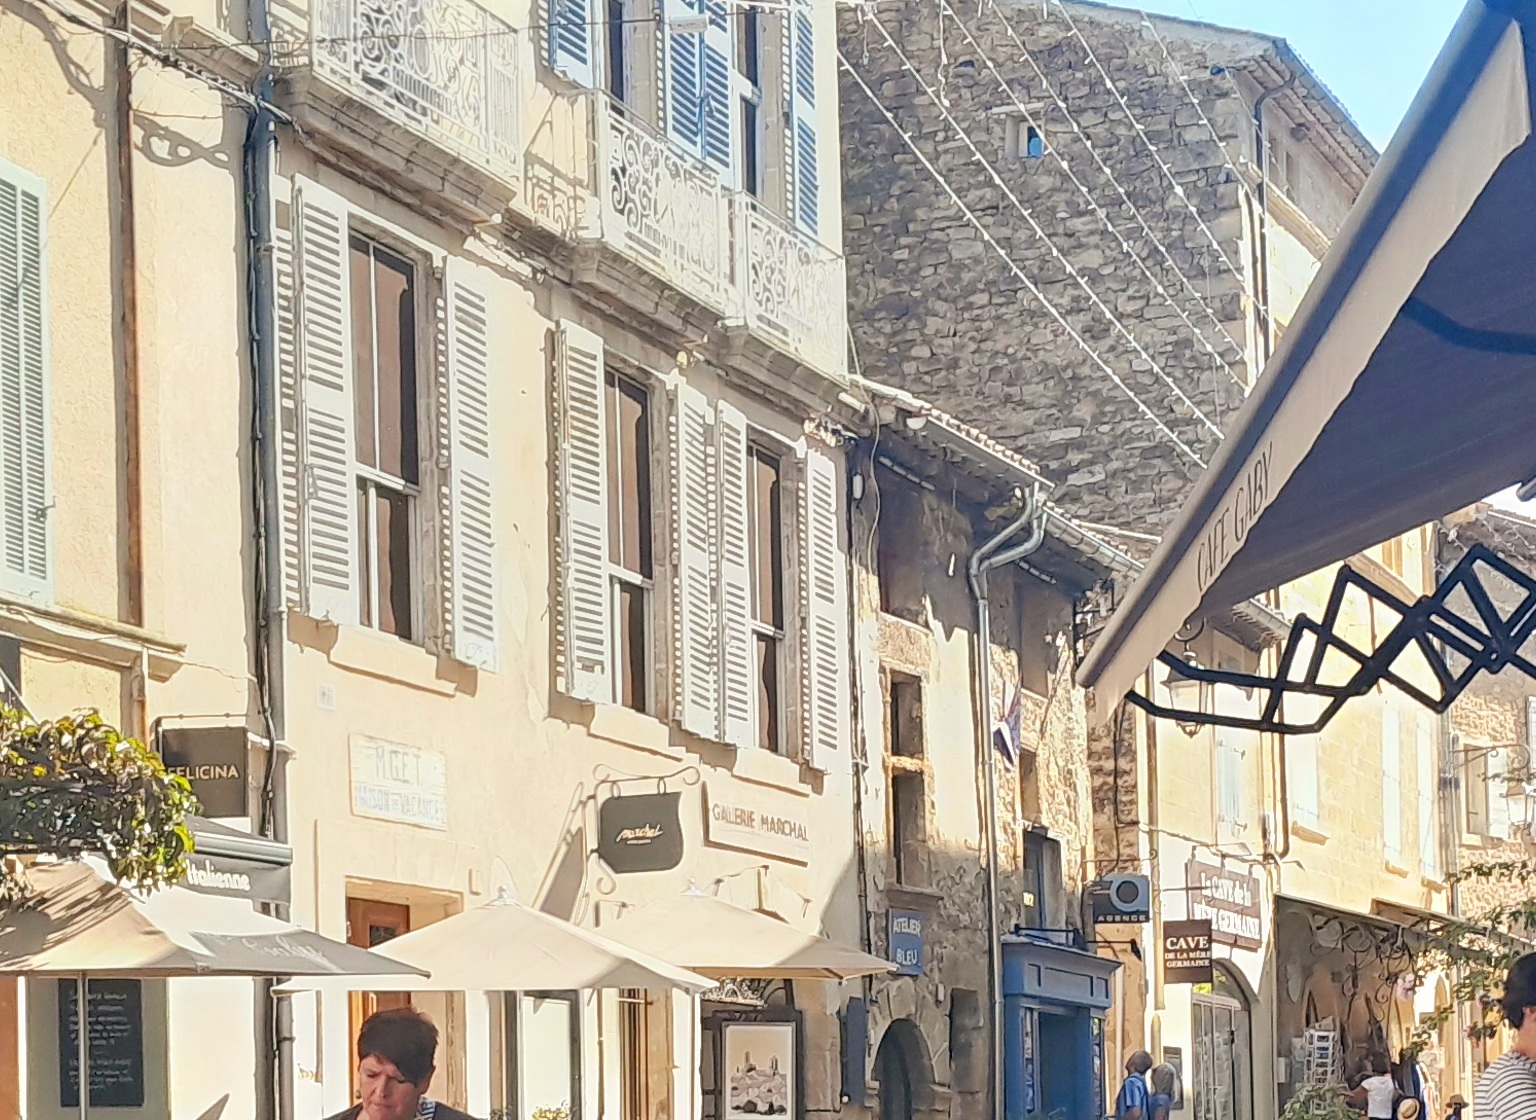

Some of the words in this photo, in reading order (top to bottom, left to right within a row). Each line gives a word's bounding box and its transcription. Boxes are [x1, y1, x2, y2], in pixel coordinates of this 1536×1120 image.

[1234, 441, 1273, 543] GABY
[760, 813, 810, 842] MARCHAL
[1097, 914, 1147, 922] AGENCE
[892, 917, 921, 936] ATELIER
[1166, 936, 1209, 950] CAVE
[896, 948, 918, 966] BLEU
[1166, 960, 1210, 968] GERMAINE
[1177, 952, 1188, 960] LA
